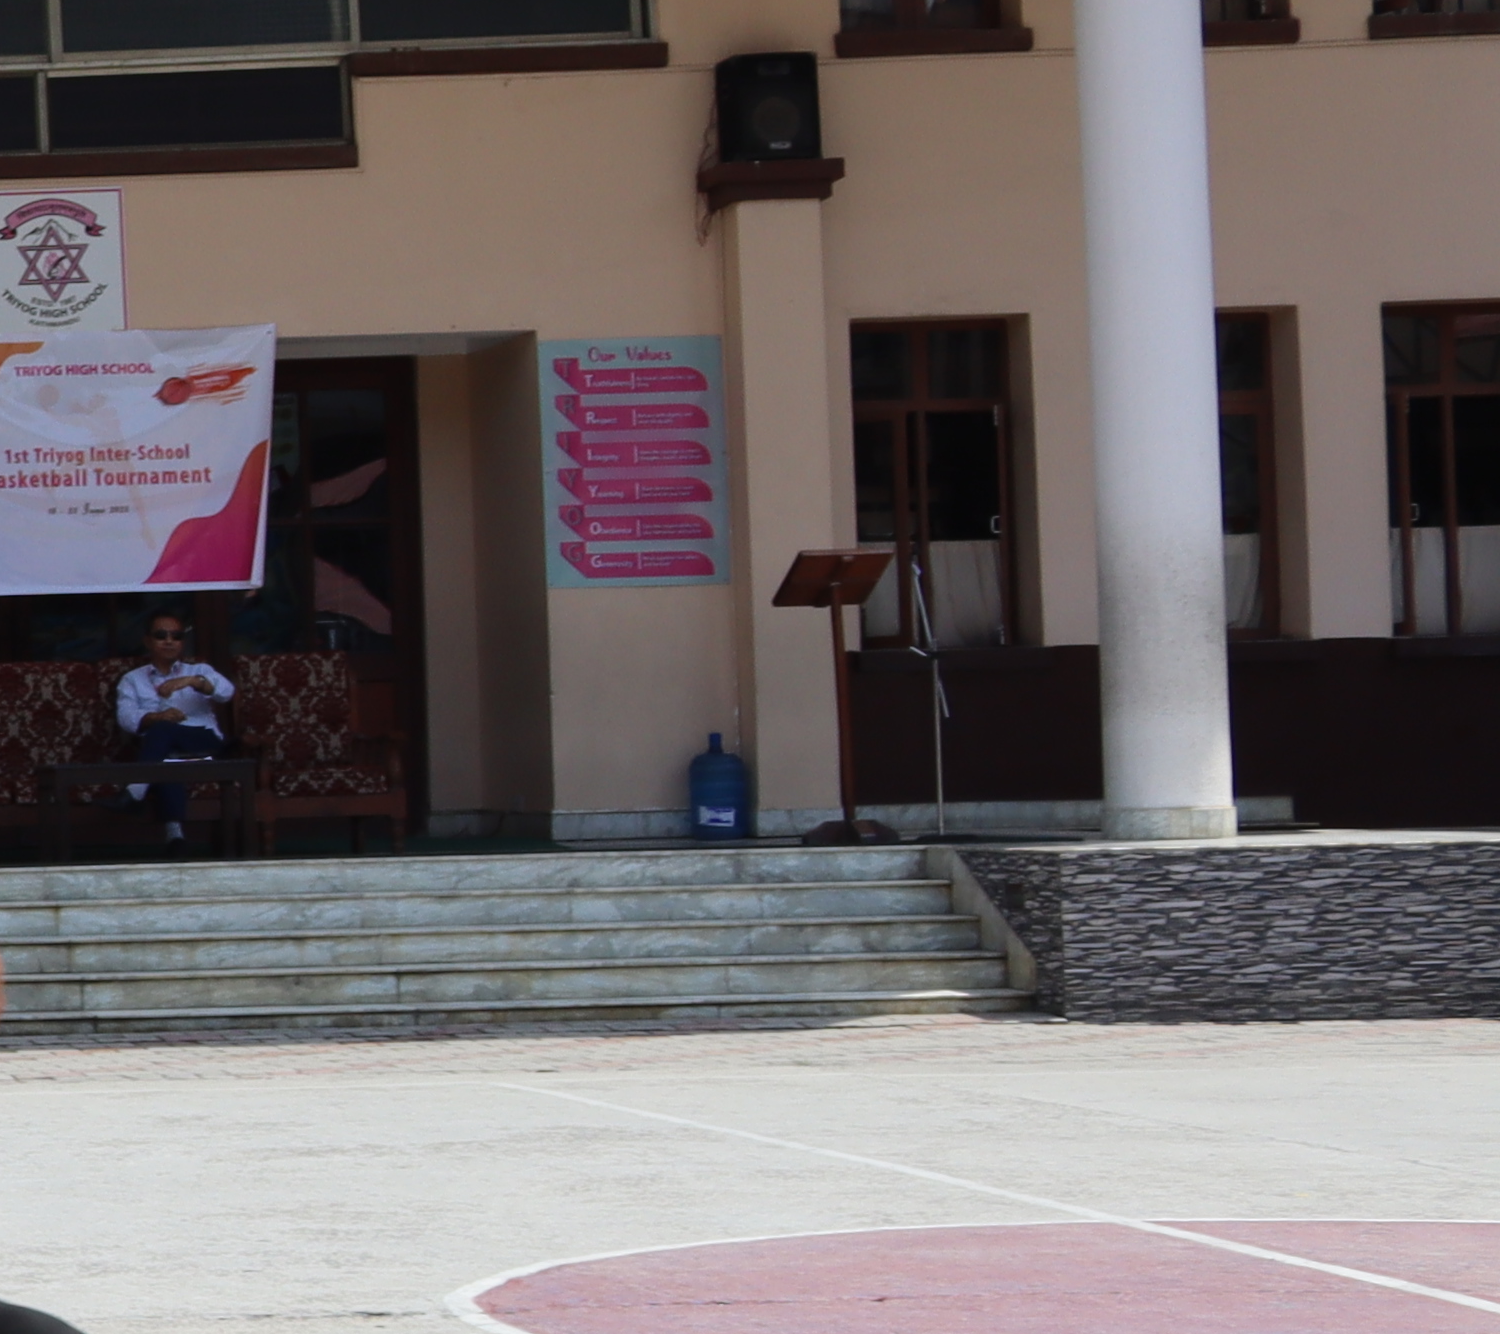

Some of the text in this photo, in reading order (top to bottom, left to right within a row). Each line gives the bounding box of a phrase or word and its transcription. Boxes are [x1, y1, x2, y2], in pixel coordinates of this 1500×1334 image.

[1, 288, 38, 317] TRIYOG
[39, 306, 70, 318] HIGH
[69, 282, 110, 316] SCHOOL
[587, 344, 673, 363] Our Values
[13, 362, 155, 378] TRIYOG HIGH SCHOOL
[4, 443, 191, 466] 1st Triyog Inter-School
[93, 466, 213, 486] Tournament
